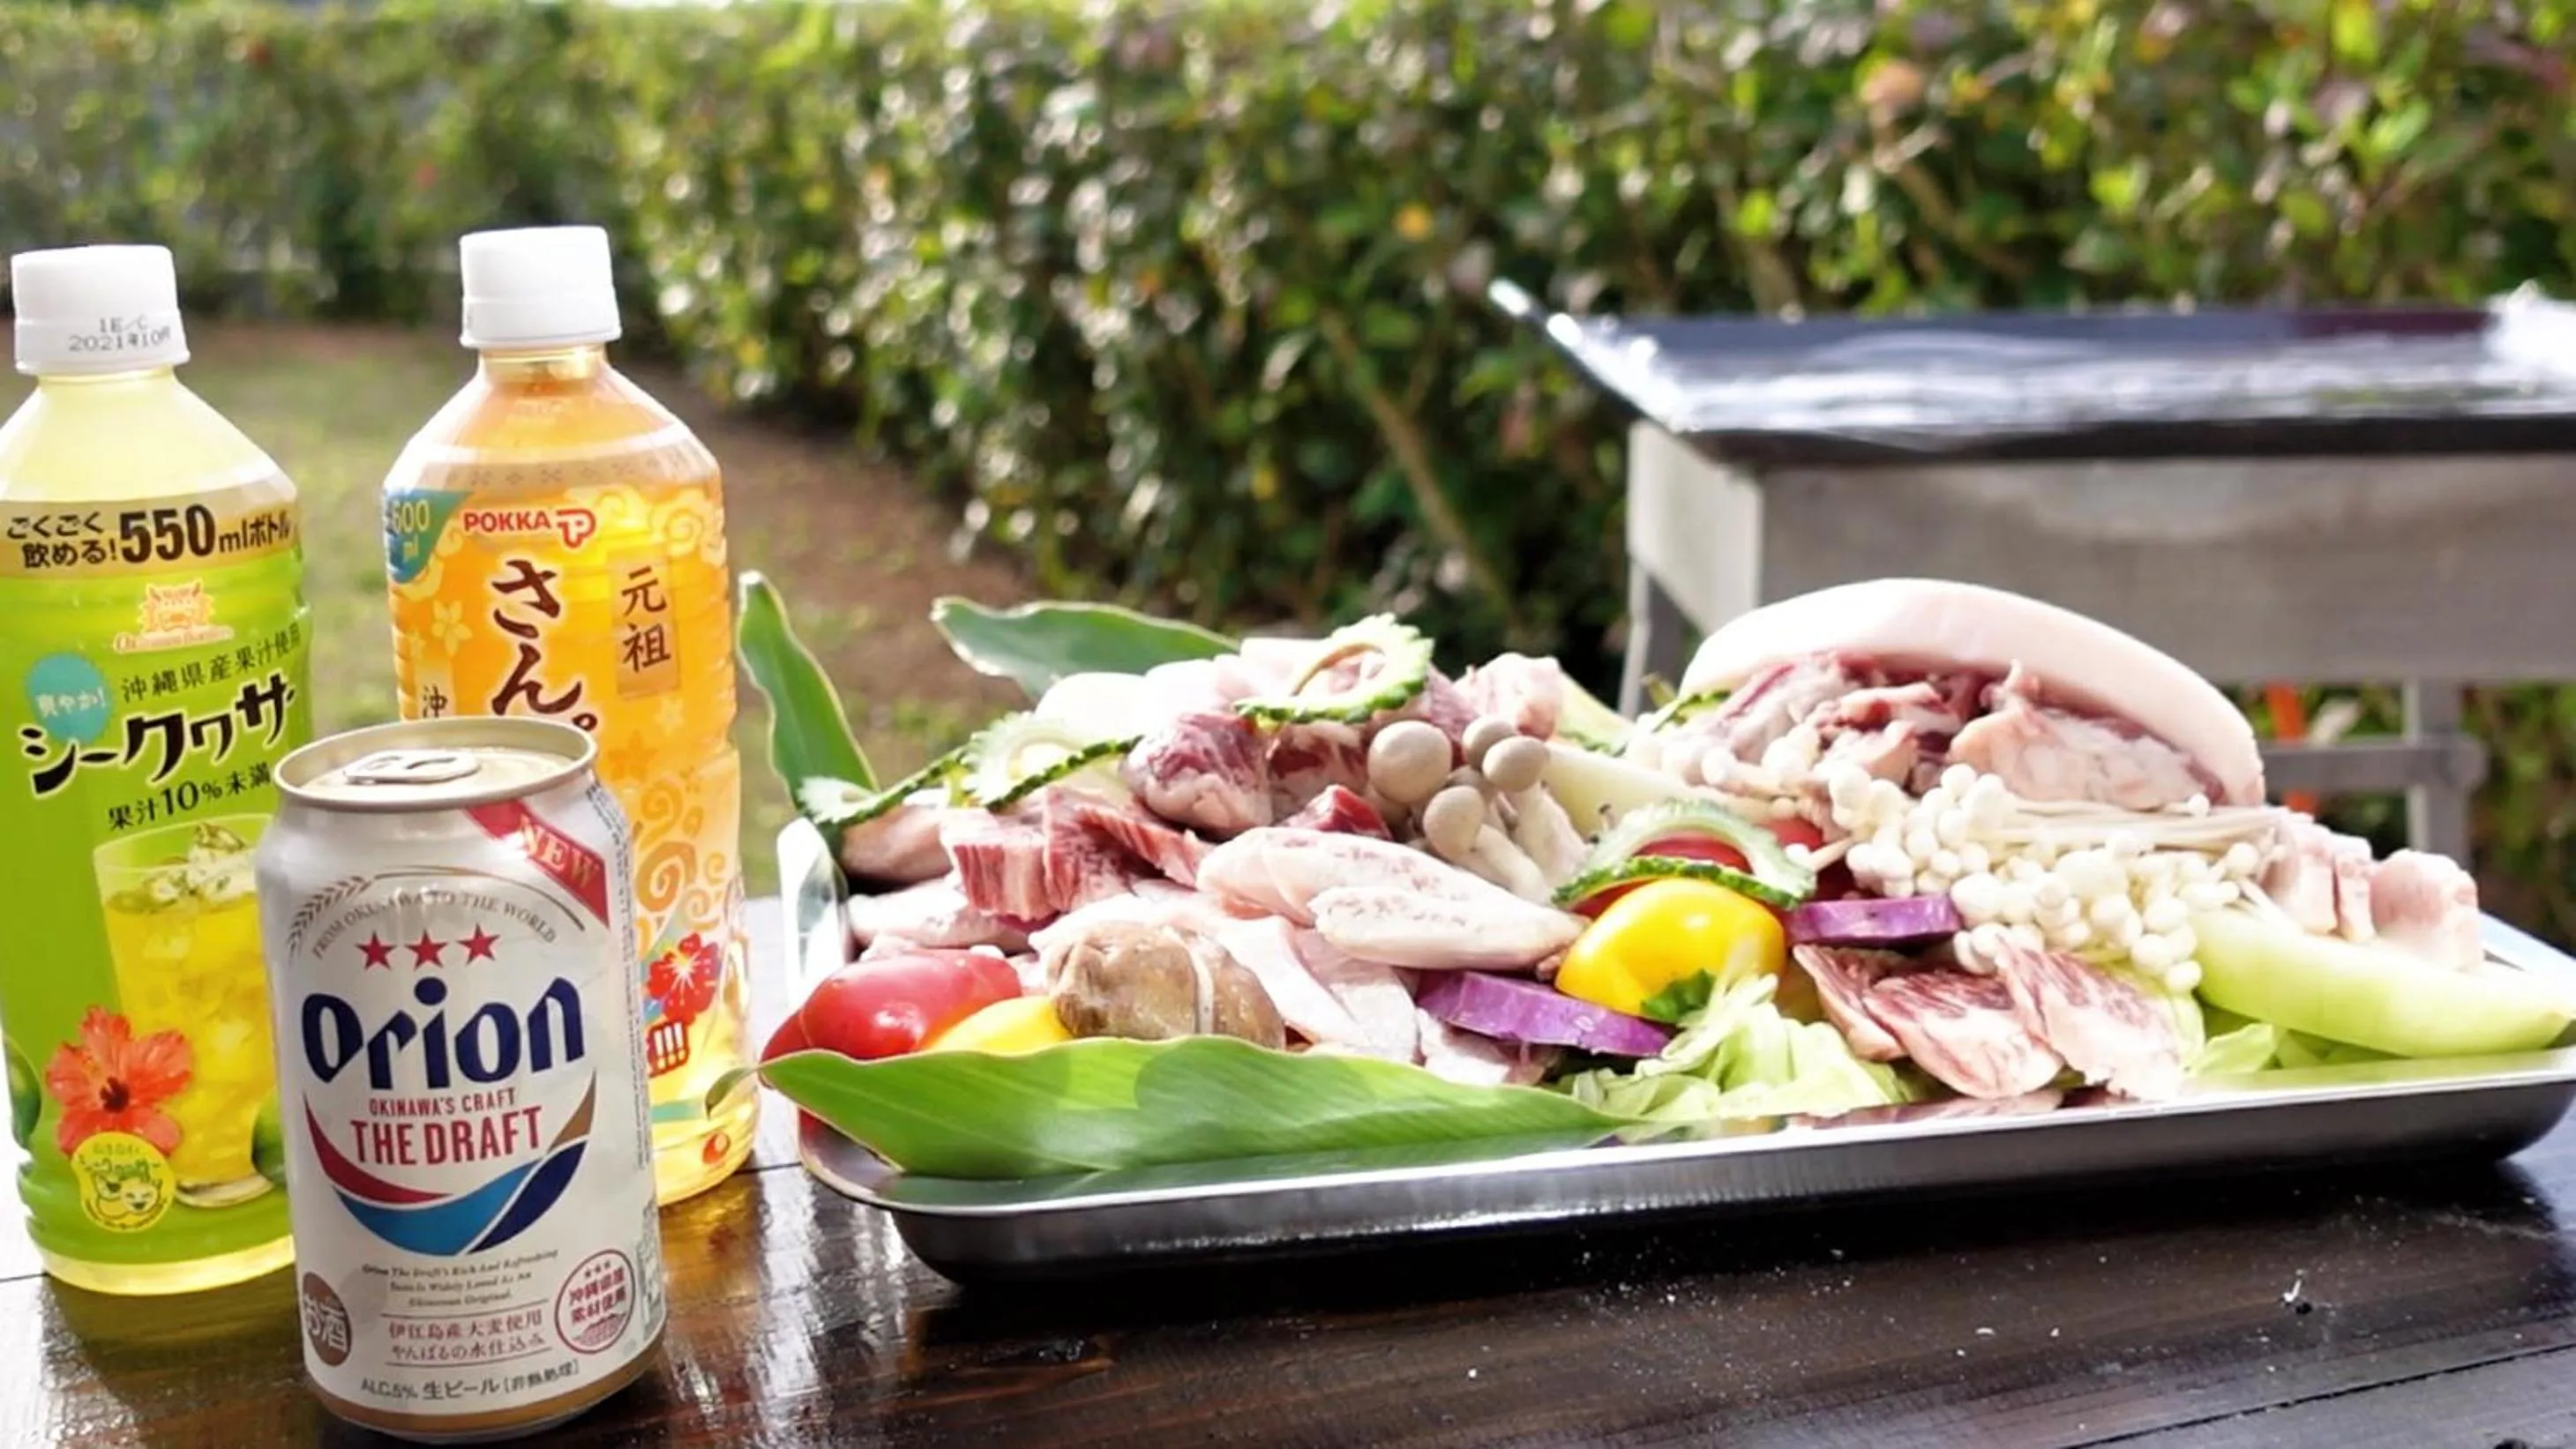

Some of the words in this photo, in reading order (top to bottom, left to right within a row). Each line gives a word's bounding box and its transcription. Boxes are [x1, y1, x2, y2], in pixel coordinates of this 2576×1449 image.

[7, 512, 104, 539] ごくごく
[463, 510, 551, 533] POKKA
[490, 558, 598, 732] さん
[620, 565, 672, 674] 元祖
[519, 812, 602, 890] NEW
[311, 917, 345, 960] FROM
[461, 892, 498, 914] THE
[502, 901, 558, 945] WORLD
[369, 1096, 457, 1117] OKINAWA'S
[461, 1087, 518, 1115] CRAFT
[350, 1118, 417, 1166] THE
[423, 1105, 543, 1166] DRAFT
